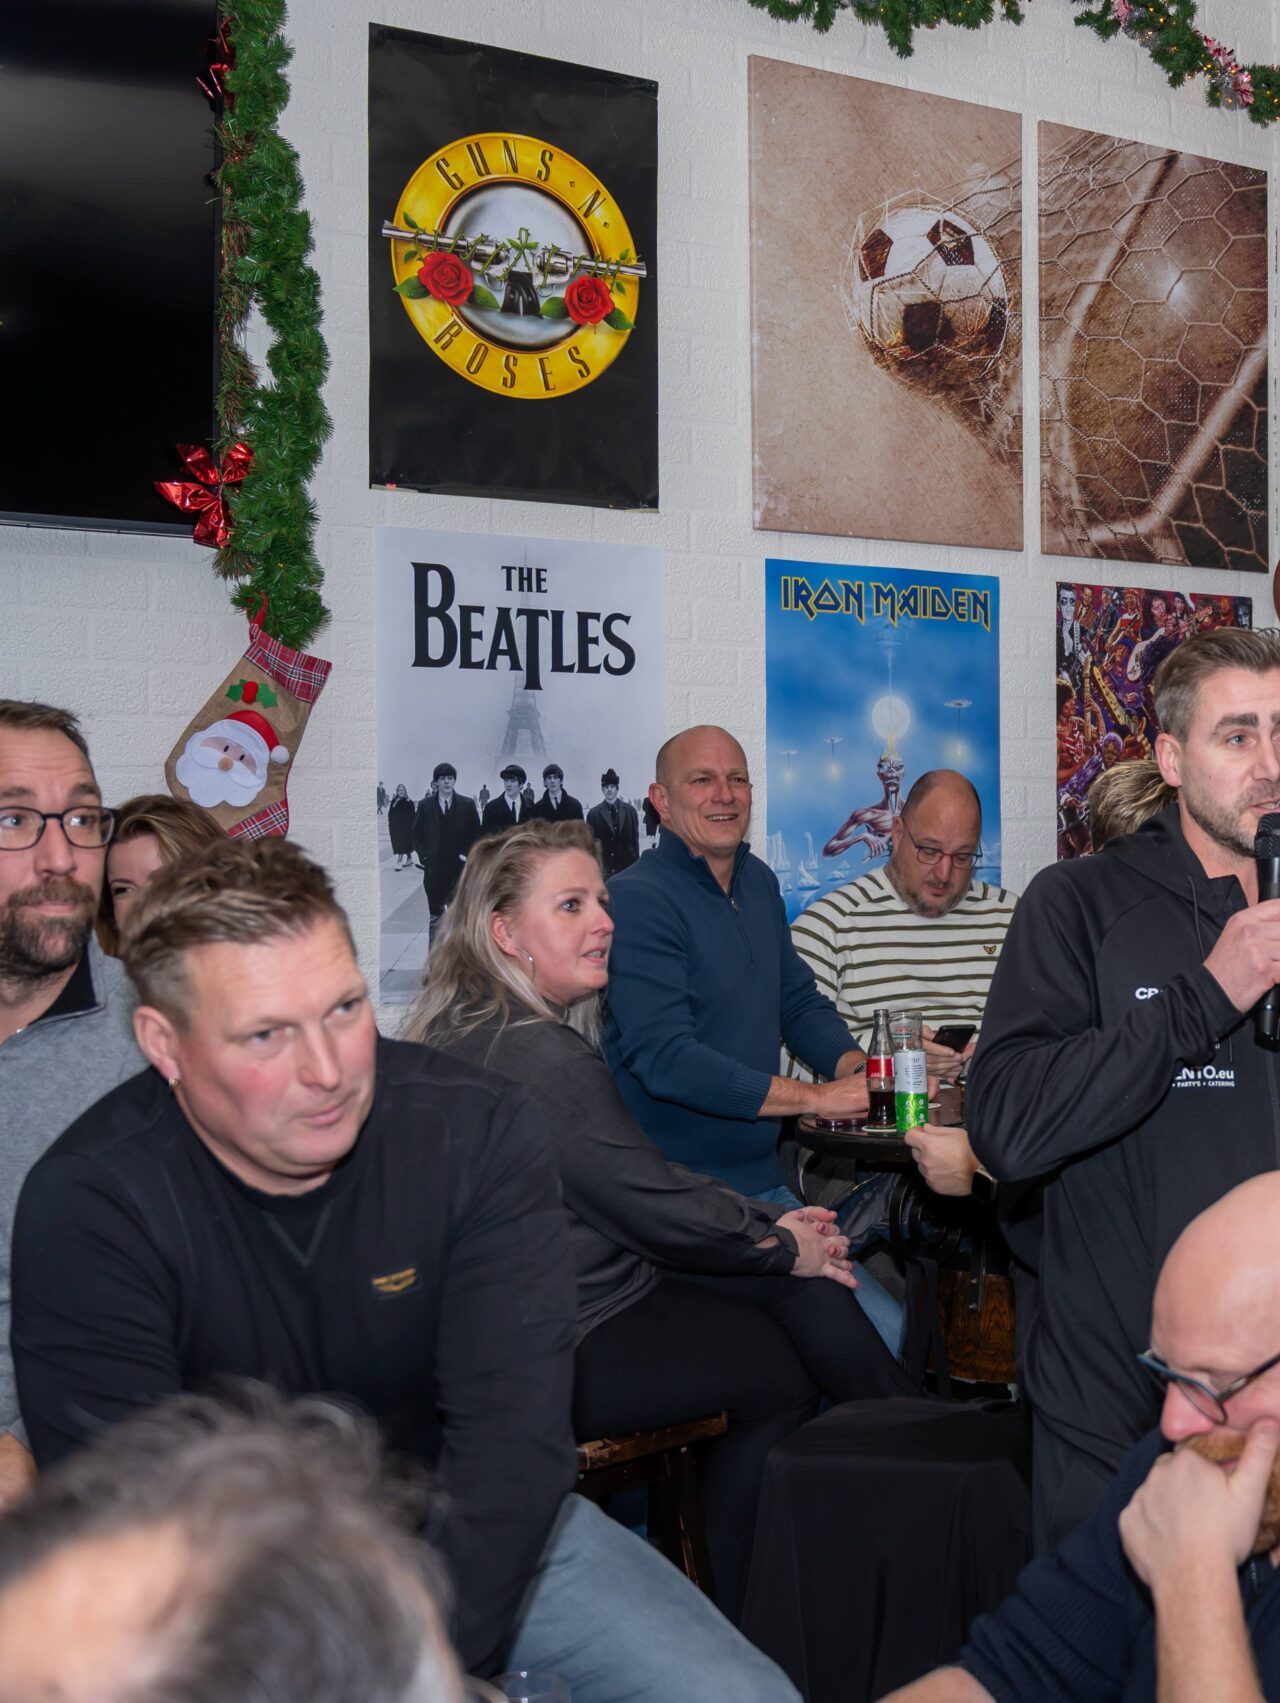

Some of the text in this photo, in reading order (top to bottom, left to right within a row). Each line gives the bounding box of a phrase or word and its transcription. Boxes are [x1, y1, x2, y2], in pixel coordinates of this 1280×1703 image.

[435, 139, 555, 190] GUNS
[432, 319, 591, 392] ROSES
[501, 565, 548, 593] THE
[781, 576, 991, 632] IRON MAIDEN
[410, 562, 636, 691] BEATLES
[1207, 1080, 1235, 1088] CATERING
